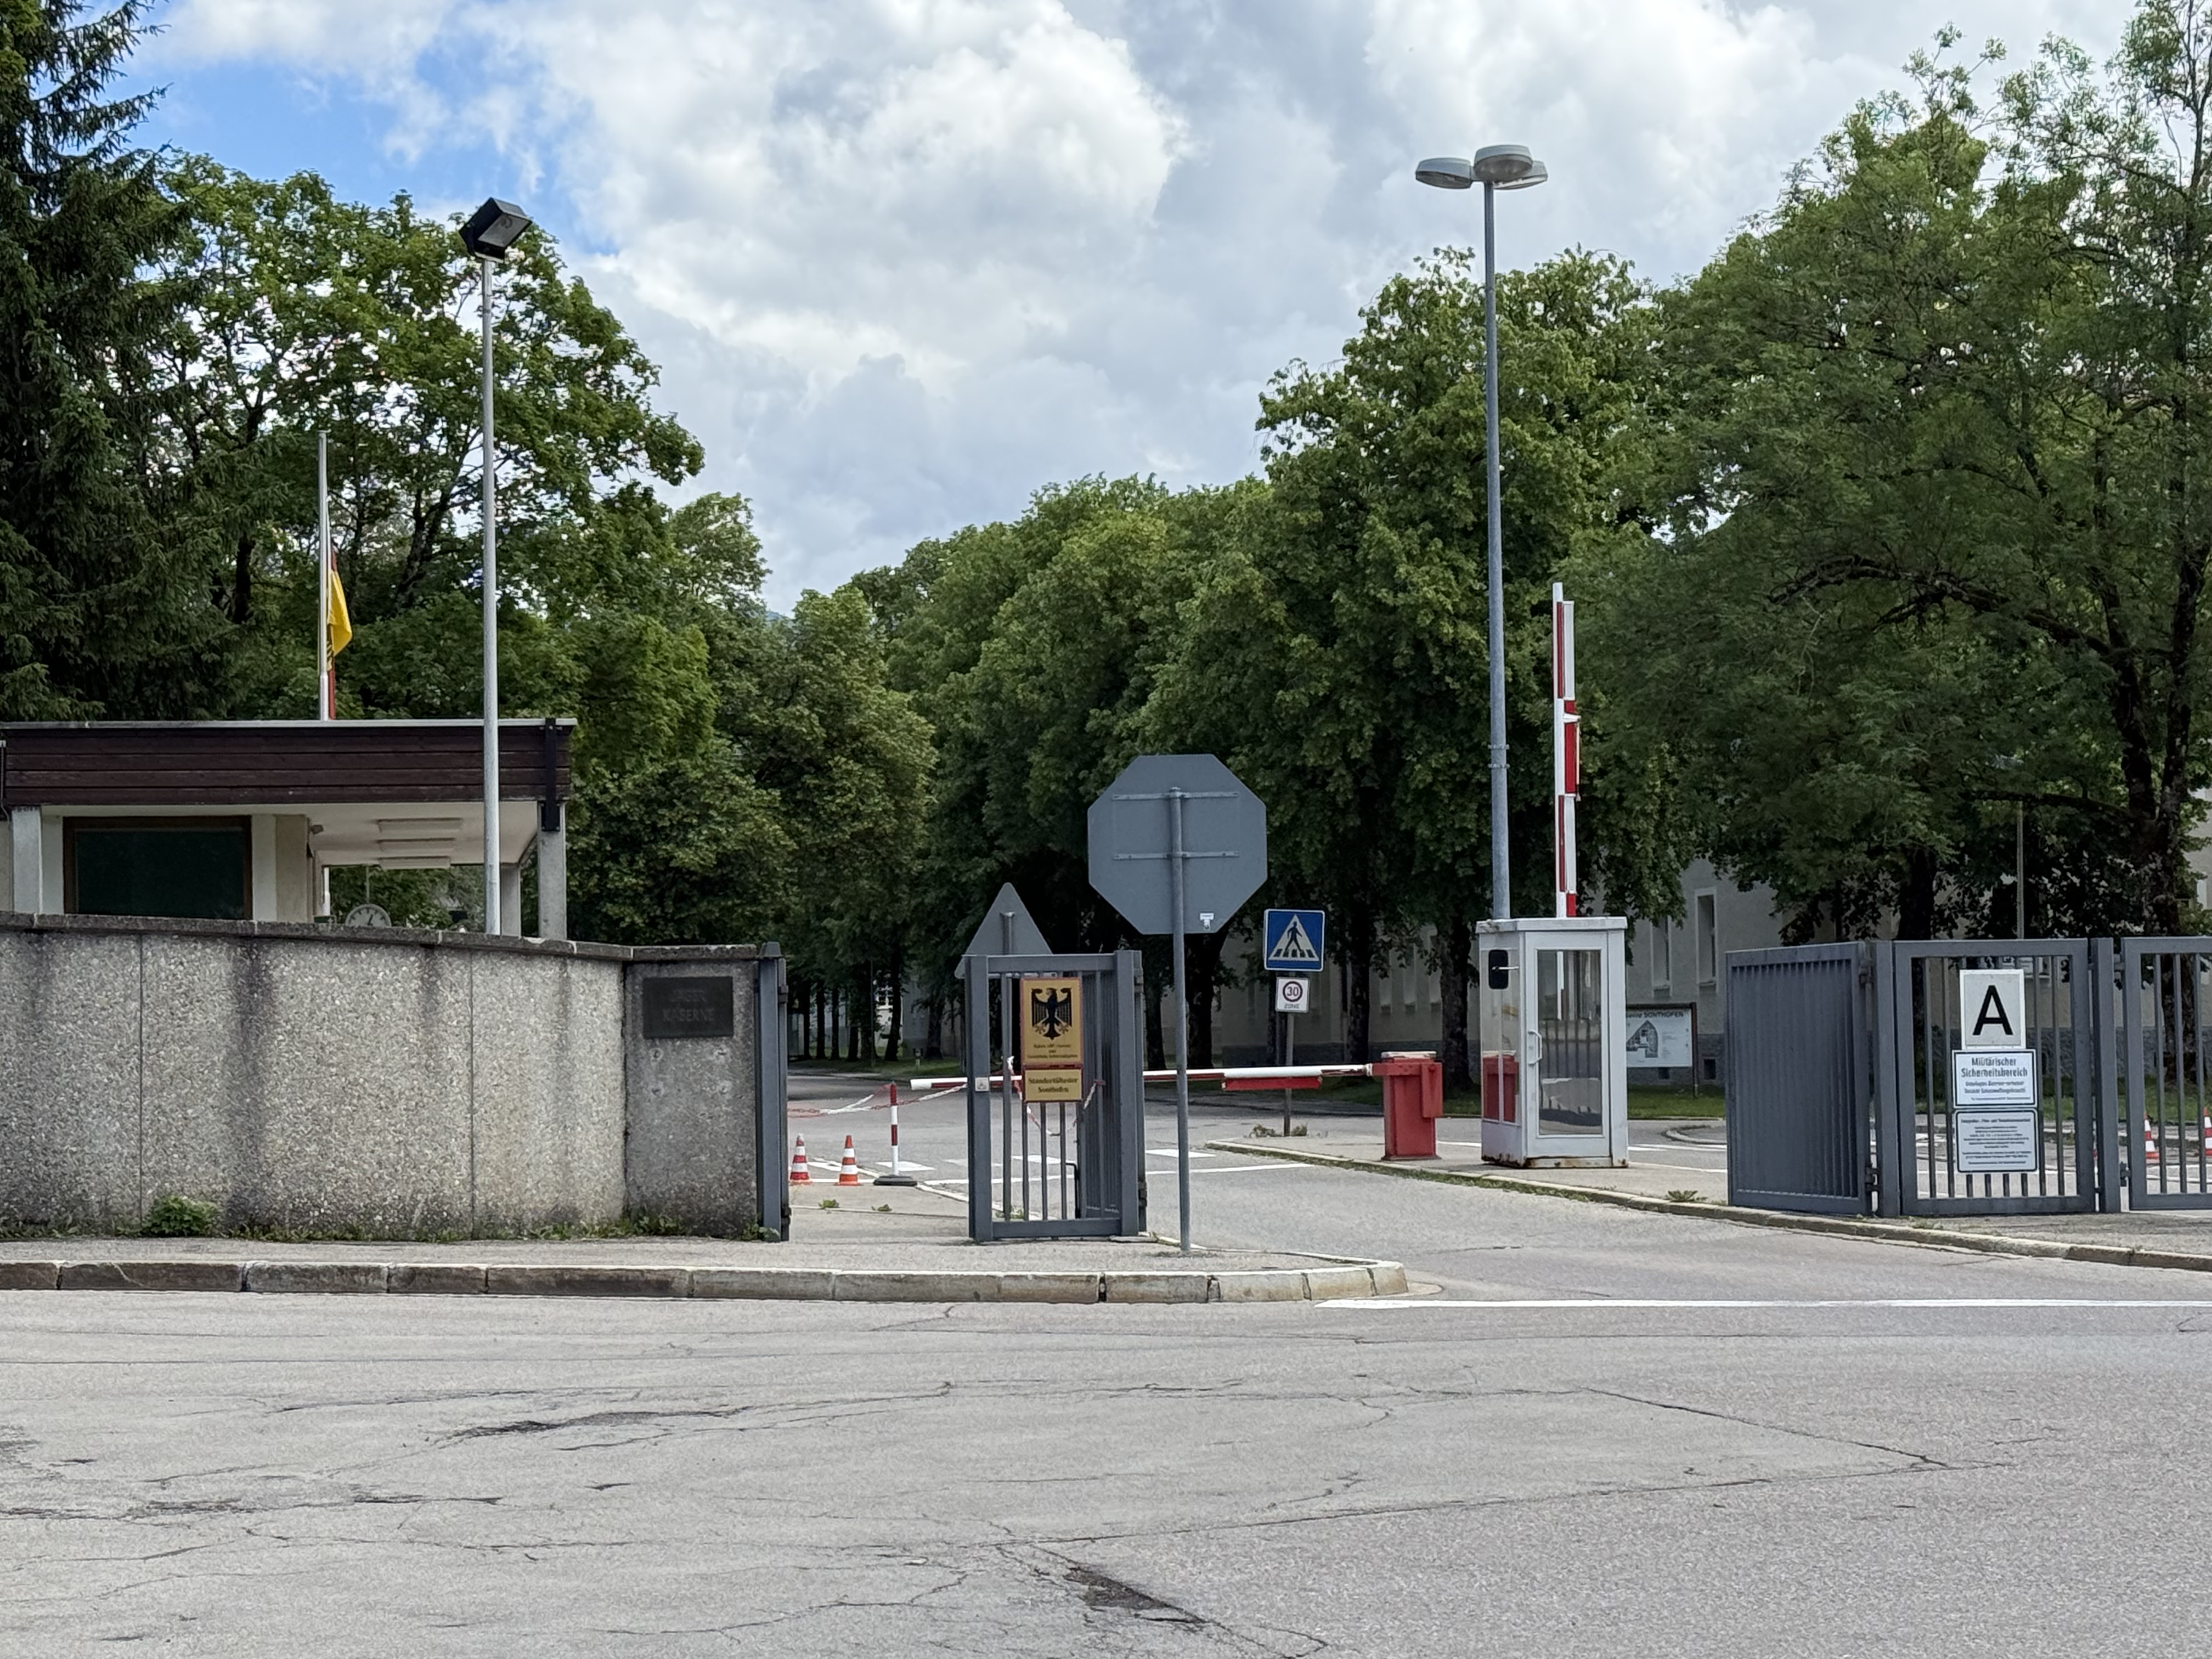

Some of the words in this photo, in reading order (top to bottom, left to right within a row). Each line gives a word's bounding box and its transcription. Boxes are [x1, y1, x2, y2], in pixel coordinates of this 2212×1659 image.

[1287, 986, 1299, 997] 30
[662, 1008, 715, 1022] KASERNE
[1972, 985, 2014, 1036] A
[1971, 1057, 2017, 1066] Militärischer
[1961, 1067, 2028, 1078] Sicherheitsbereich
